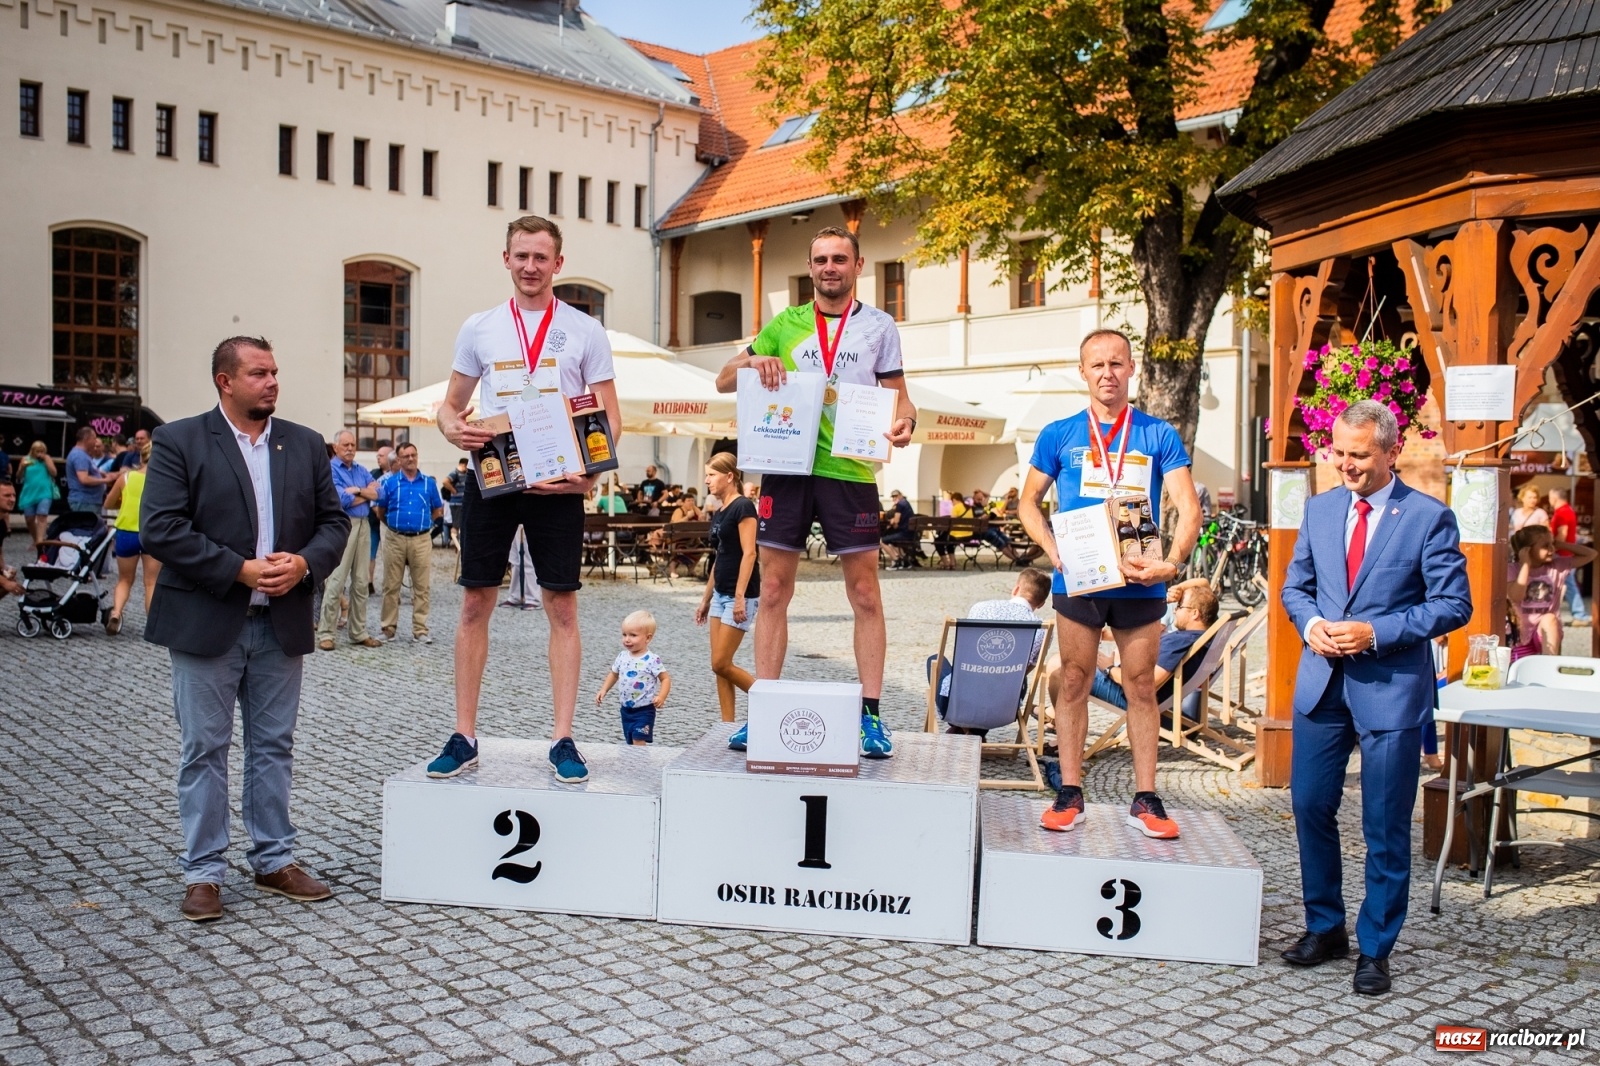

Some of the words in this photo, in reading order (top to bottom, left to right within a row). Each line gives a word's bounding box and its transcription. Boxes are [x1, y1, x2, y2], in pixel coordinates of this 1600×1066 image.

[2, 391, 65, 407] TRUCK
[653, 402, 709, 415] RACIBORSKIE
[936, 414, 987, 429] RACIBORSKIE
[753, 425, 801, 436] Lekkoatletyka
[804, 728, 822, 740] 1567
[798, 795, 831, 869] 1
[492, 810, 541, 883] 2
[717, 883, 776, 906] OSIR
[784, 889, 911, 916] RACIBÓRZ
[1097, 879, 1142, 940] 3
